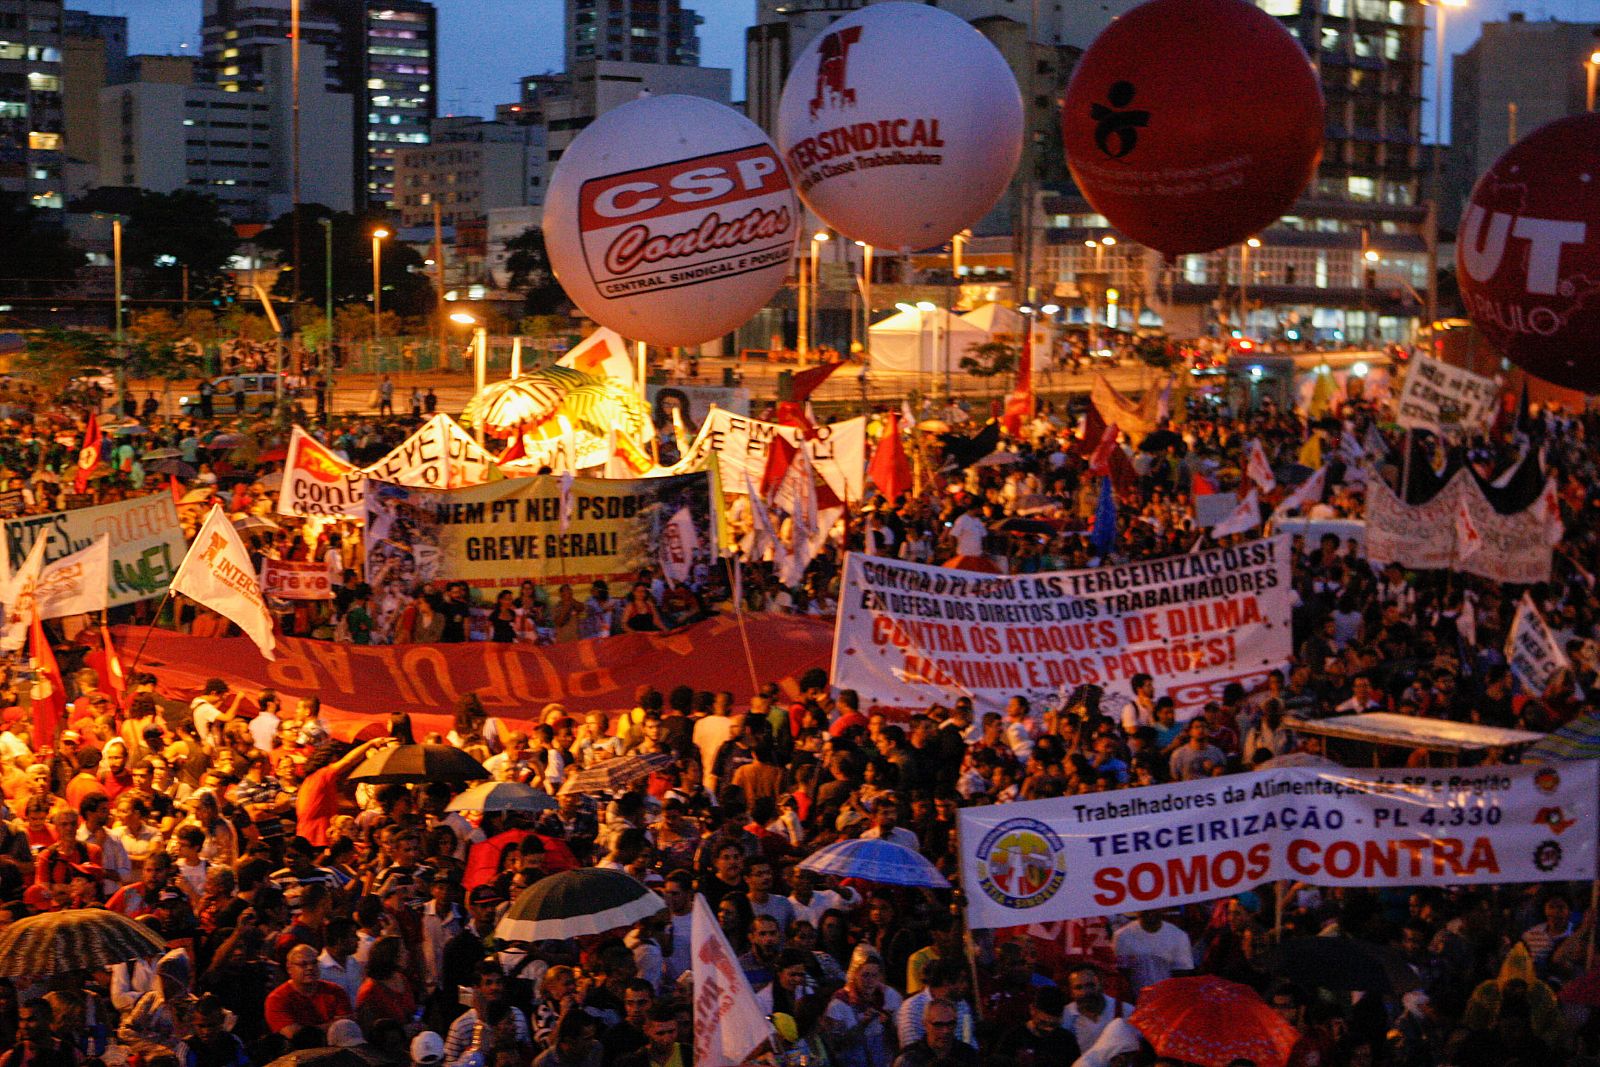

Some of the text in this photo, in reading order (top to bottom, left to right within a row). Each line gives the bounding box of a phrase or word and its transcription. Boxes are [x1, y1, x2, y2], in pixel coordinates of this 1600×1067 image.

[593, 156, 776, 218] CSP
[604, 205, 790, 275] Conlutas
[1463, 203, 1587, 296] UT
[605, 275, 665, 294] CENTRAL
[669, 262, 735, 283] SINDICAL
[738, 259, 748, 269] E
[437, 502, 485, 525] NEM
[492, 498, 519, 523] PT
[466, 531, 618, 562] GREVE GERAL!
[863, 561, 932, 594] CONTRA
[973, 577, 1016, 600] 4330
[1020, 578, 1033, 600] E
[1035, 576, 1064, 599] AS
[891, 593, 944, 619] DEFESA
[944, 602, 976, 623] DOS
[978, 603, 1055, 624] DIREITOS
[1056, 598, 1099, 622] DOS
[1103, 568, 1279, 615] TRABALHADORES
[872, 615, 967, 654] CONTRA
[969, 624, 1003, 655] OS
[1006, 619, 1119, 656] ATAQUES
[1123, 612, 1162, 645] DE
[1025, 659, 1041, 688] E
[1043, 657, 1101, 688] DOS
[1102, 635, 1237, 682] PATRÕES!
[1073, 792, 1217, 823] Trabalhadores
[1222, 785, 1246, 805] da
[1251, 777, 1367, 801] Alimentação
[1448, 775, 1513, 798] Região
[1089, 805, 1345, 858] TERCEIRIZAÇÃO
[1373, 808, 1409, 828] PL
[1420, 807, 1502, 827] 4.330
[1092, 842, 1271, 907] SOMOS
[1286, 836, 1500, 878] CONTRA
